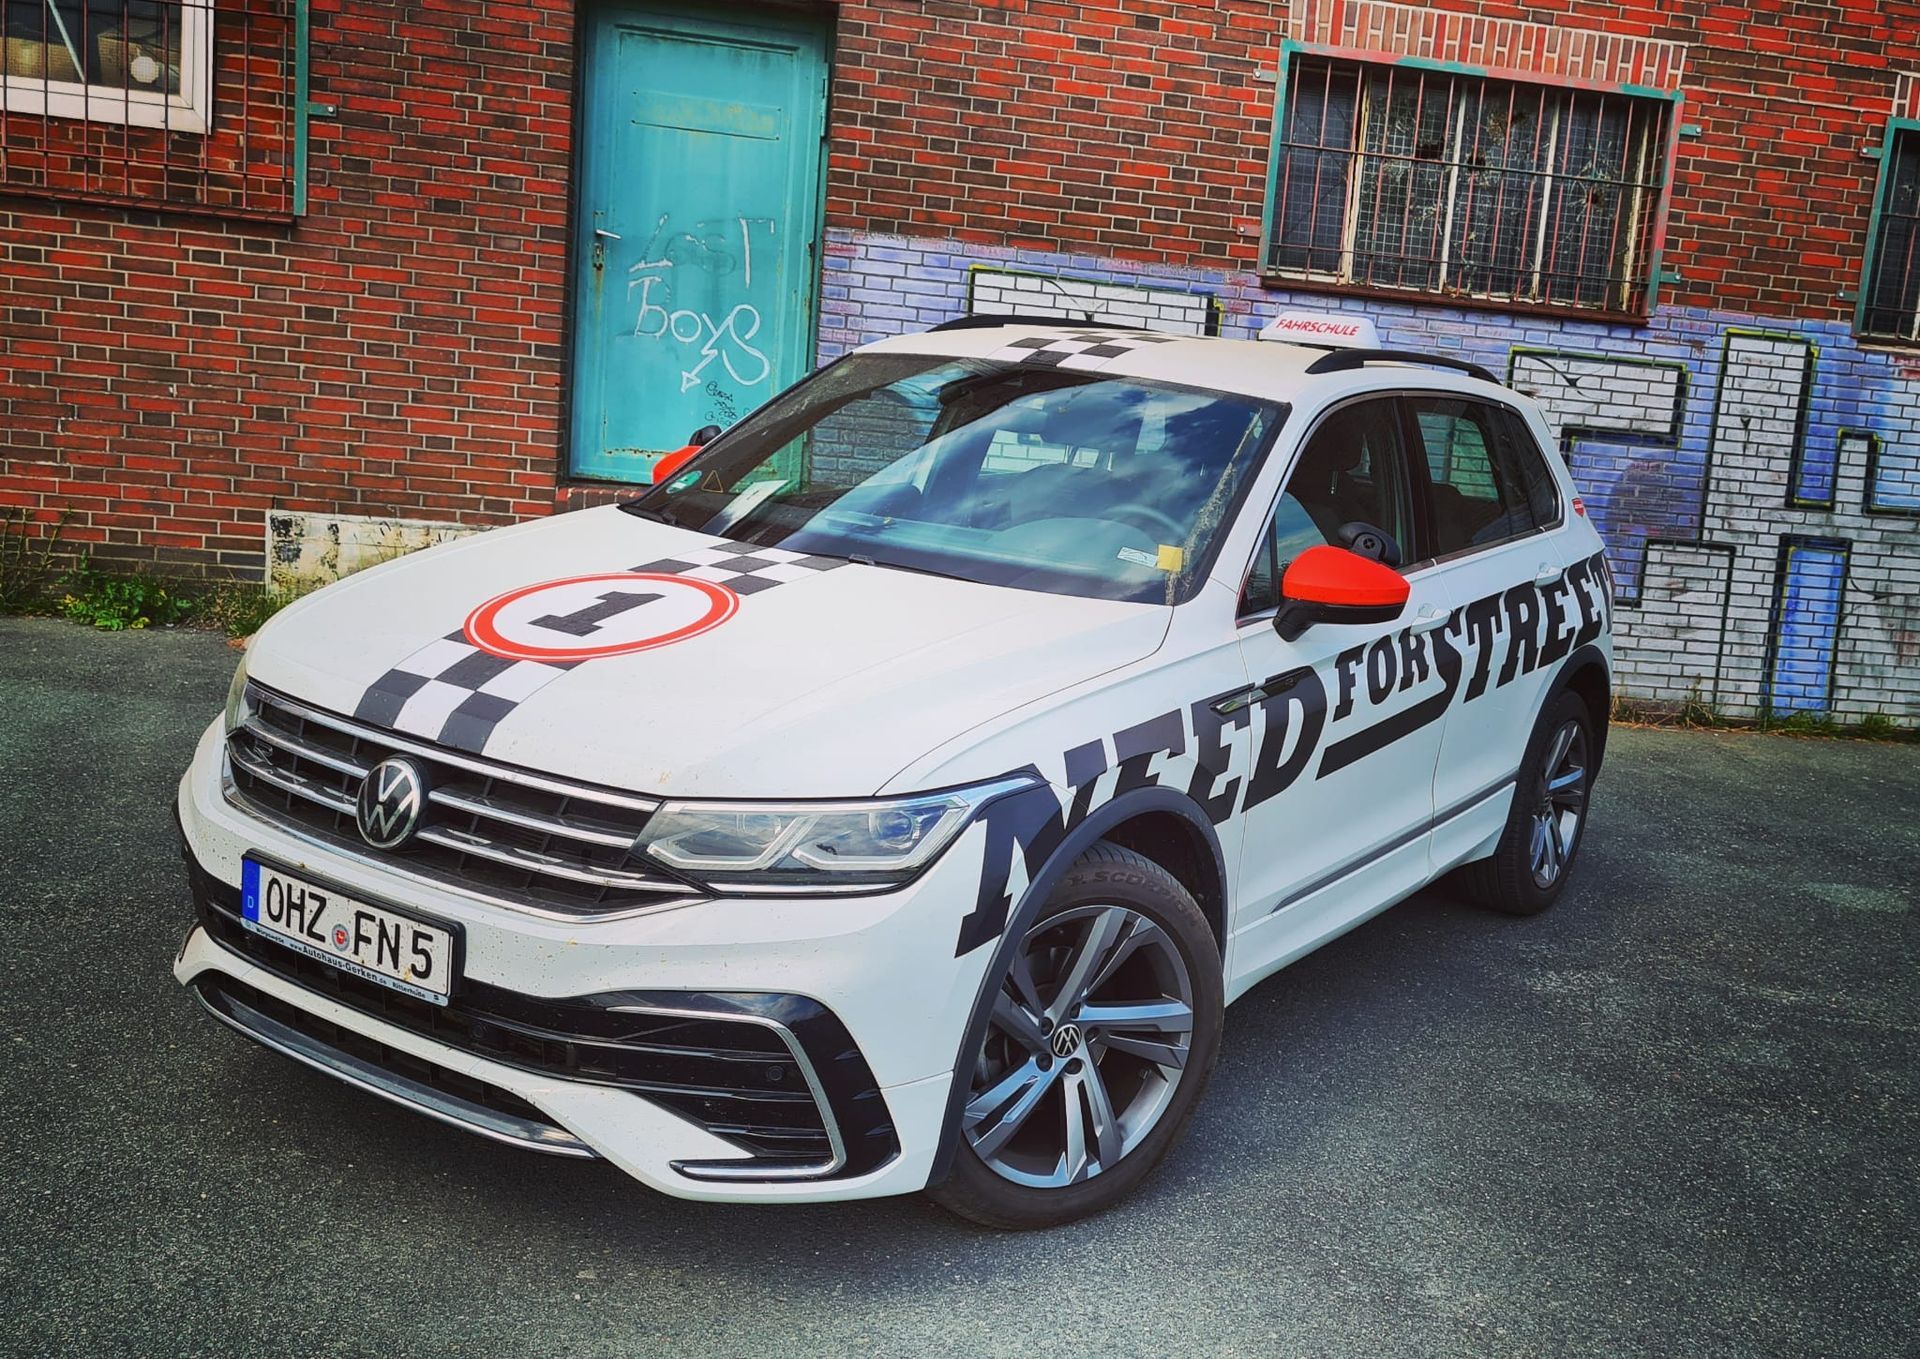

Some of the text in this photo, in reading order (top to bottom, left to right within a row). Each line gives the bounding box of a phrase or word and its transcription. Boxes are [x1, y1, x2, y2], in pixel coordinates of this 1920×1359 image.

[1275, 319, 1360, 337] FAHRSCHULE
[527, 590, 667, 637] 1
[954, 549, 1614, 958] NEED FOR STREET
[247, 895, 254, 909] D
[266, 877, 433, 980] OHZ FN 5
